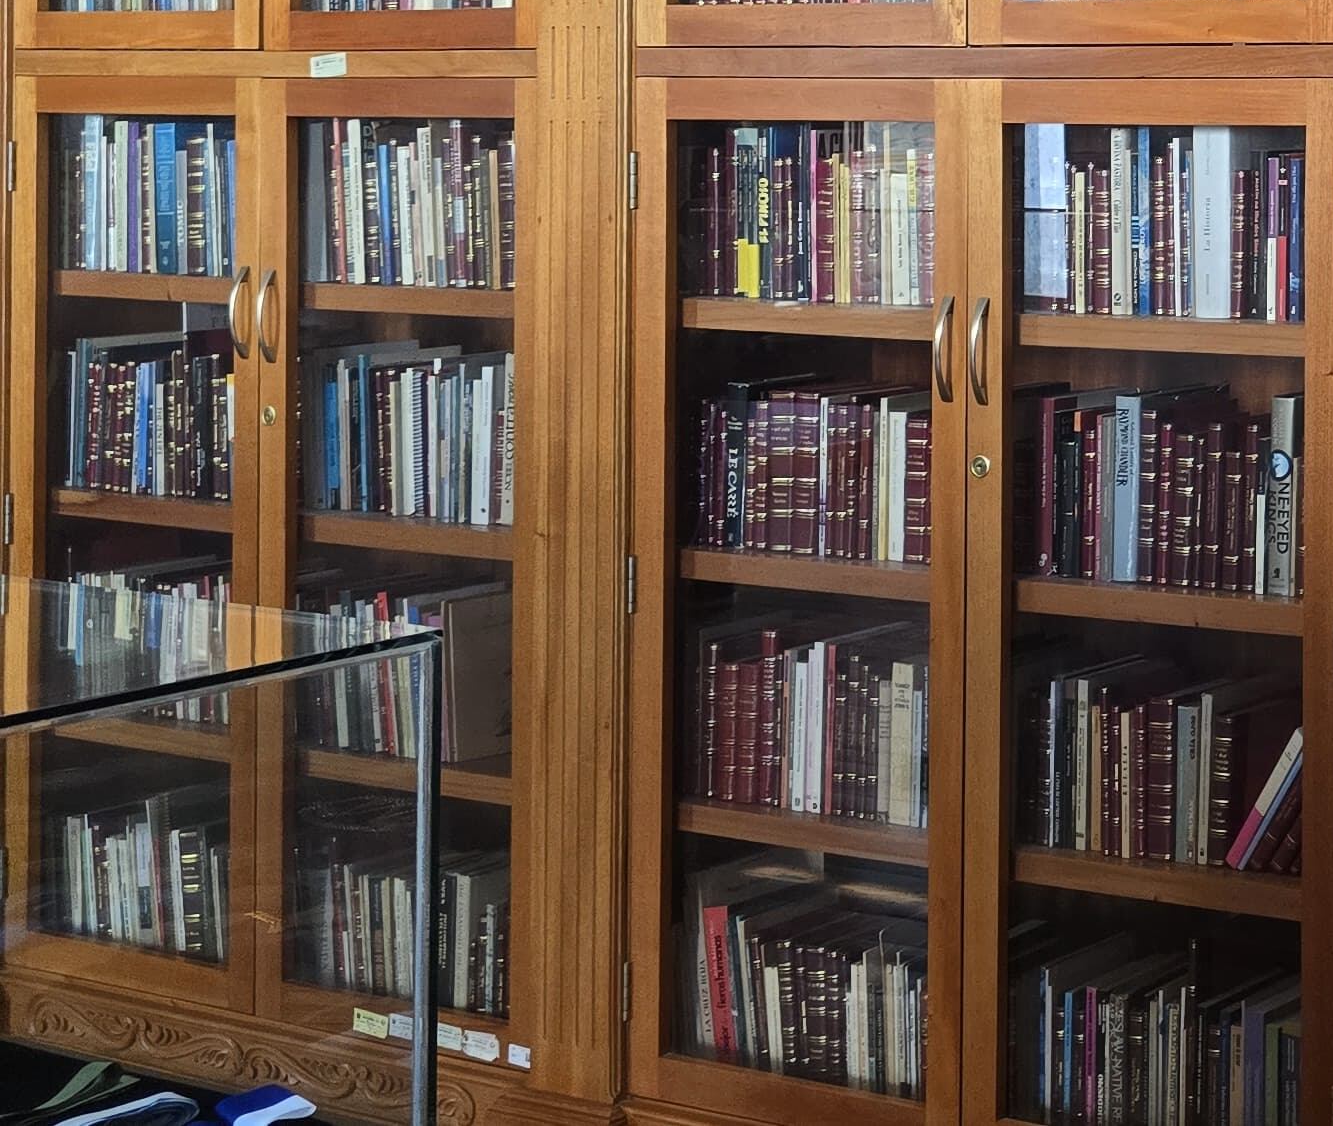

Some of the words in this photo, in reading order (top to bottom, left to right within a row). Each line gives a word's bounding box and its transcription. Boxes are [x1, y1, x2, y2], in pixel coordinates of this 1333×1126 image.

[175, 199, 185, 247] TOMIC
[1202, 197, 1212, 238] Historia
[1202, 239, 1212, 252] La
[1116, 407, 1130, 445] RAYMOND
[726, 447, 741, 469] LE
[1115, 446, 1129, 487] CHANDLER
[726, 470, 741, 519] CARRÉ
[698, 958, 709, 983] ROJA
[713, 935, 727, 981] humanas
[700, 984, 711, 1018] CRUZ
[701, 1019, 712, 1034] LA
[1111, 1058, 1123, 1103] NATIVE
